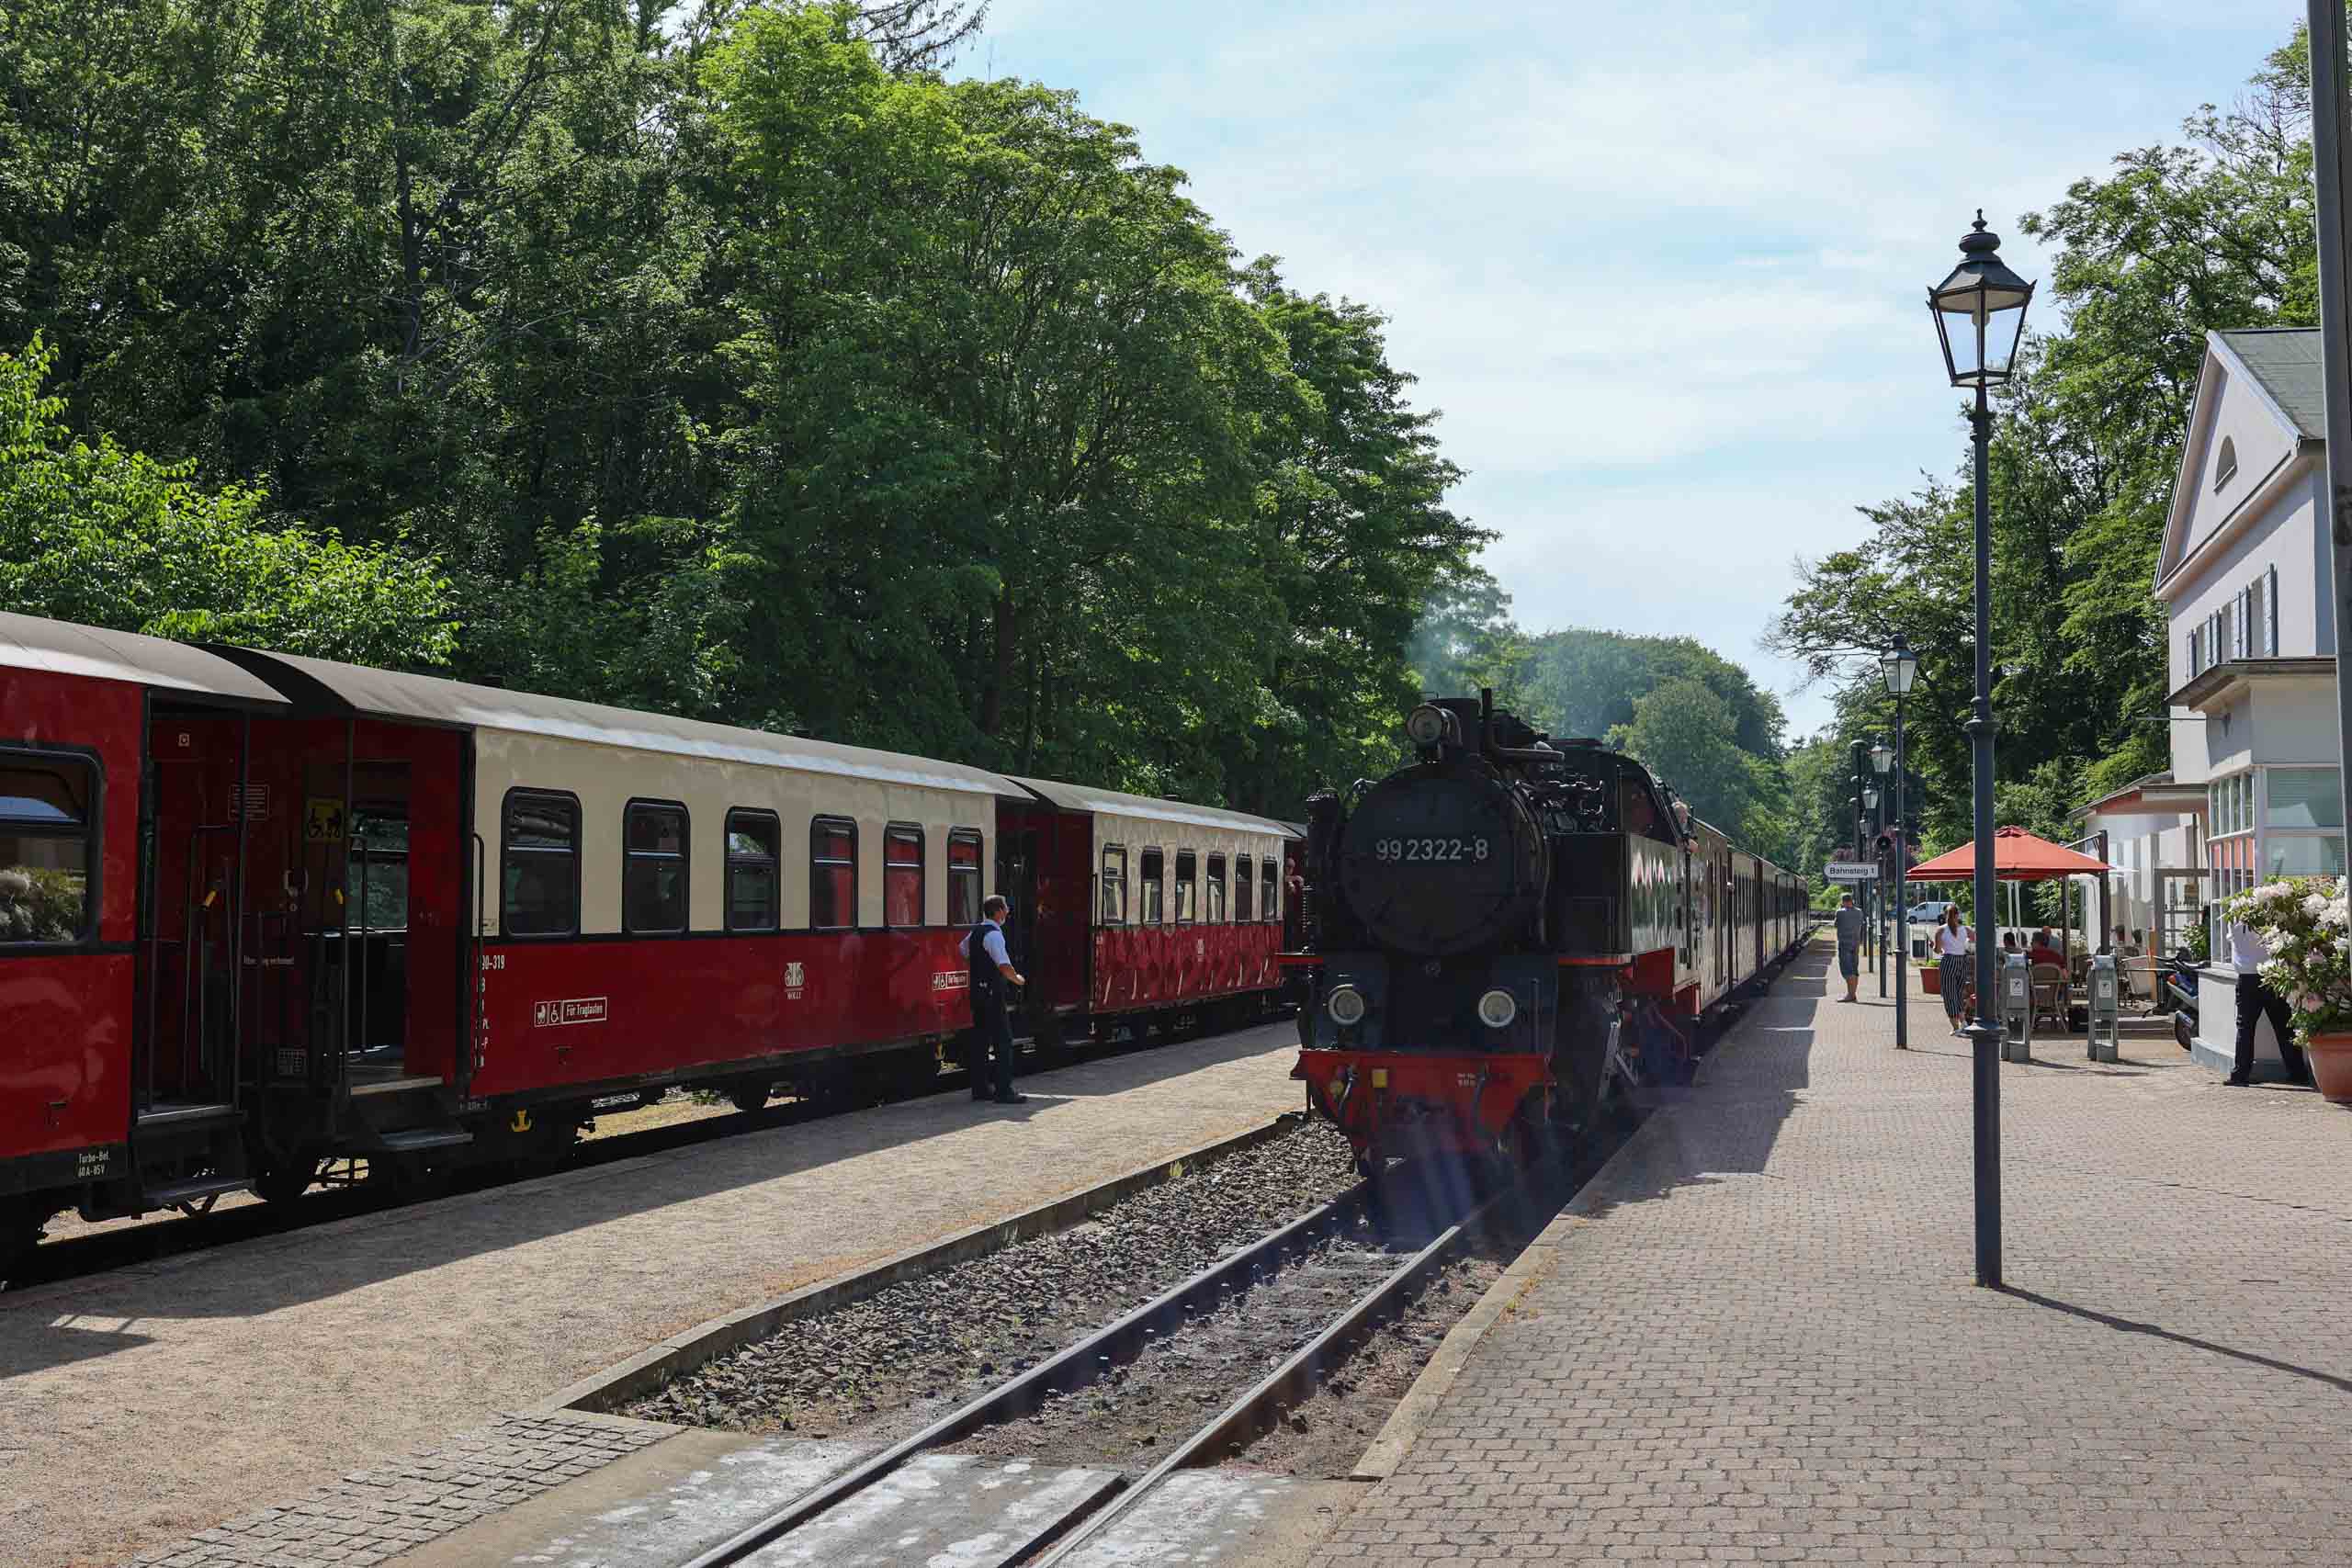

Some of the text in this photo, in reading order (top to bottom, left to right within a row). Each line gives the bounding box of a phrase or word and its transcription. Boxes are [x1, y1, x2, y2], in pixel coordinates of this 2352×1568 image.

[1375, 838, 1488, 861] 99 2322-8
[1829, 866, 1869, 876] Bahnsteig
